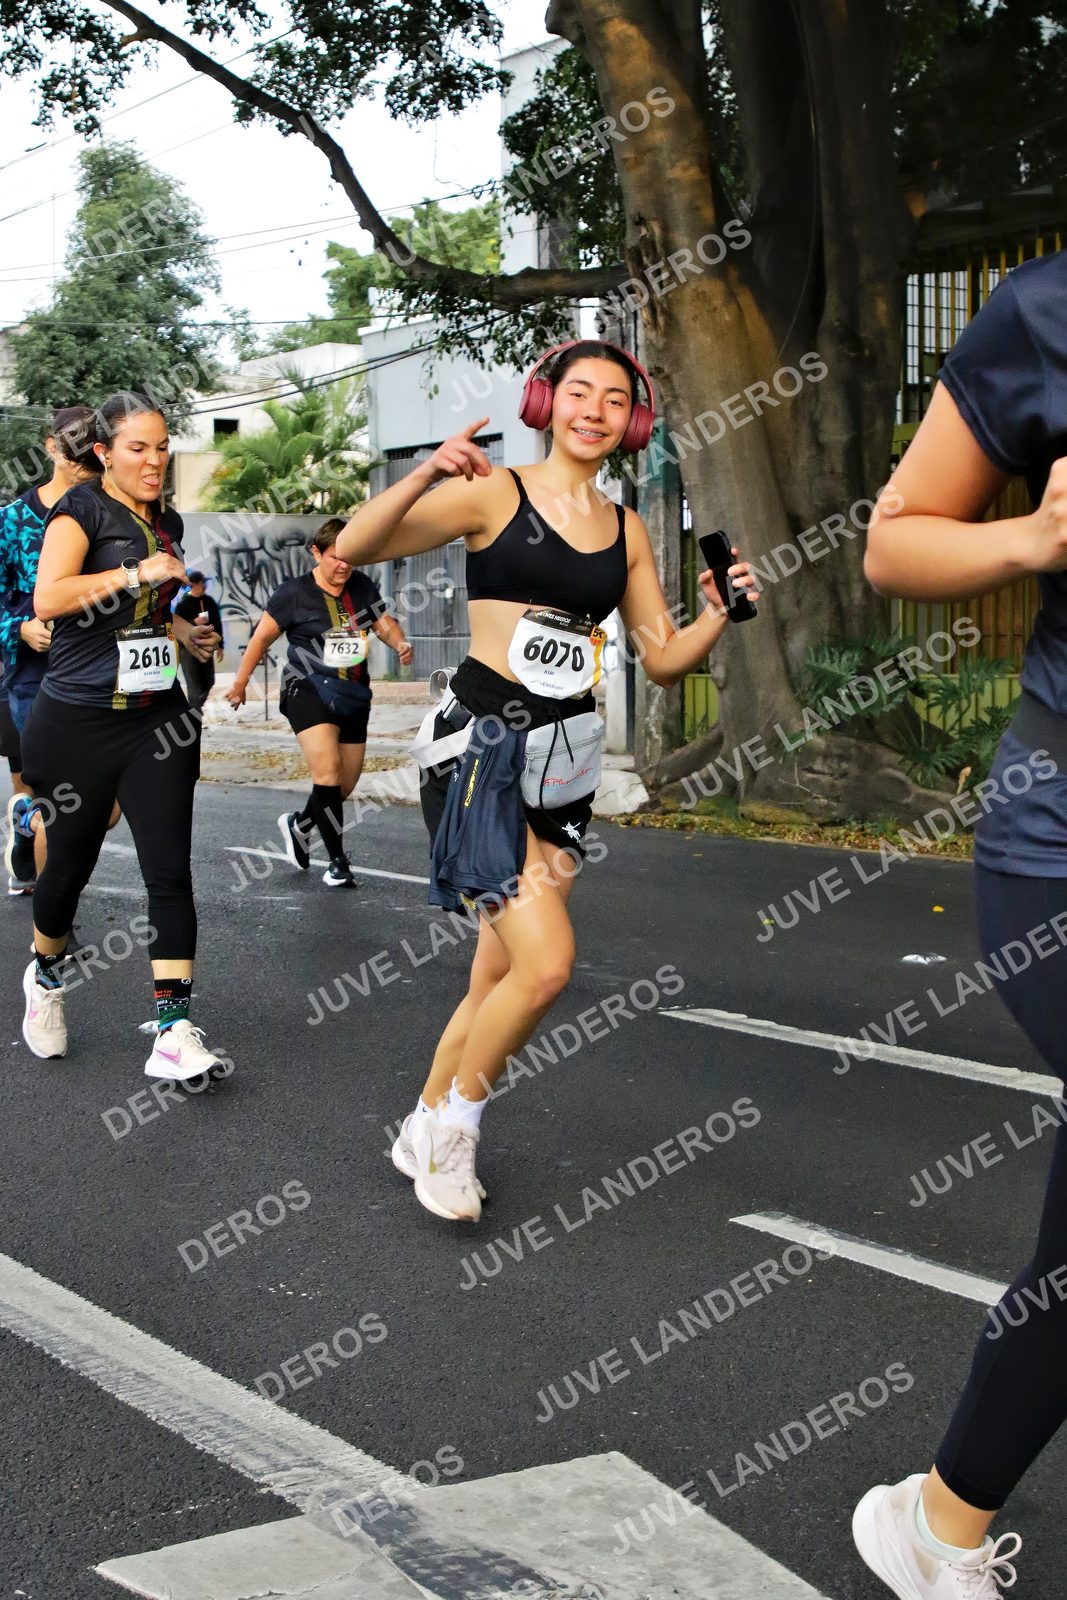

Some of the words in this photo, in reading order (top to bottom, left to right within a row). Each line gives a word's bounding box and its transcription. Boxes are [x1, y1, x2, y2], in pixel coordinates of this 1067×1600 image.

[129, 645, 170, 669] 2616
[330, 642, 359, 654] 7632
[523, 635, 585, 672] 6070
